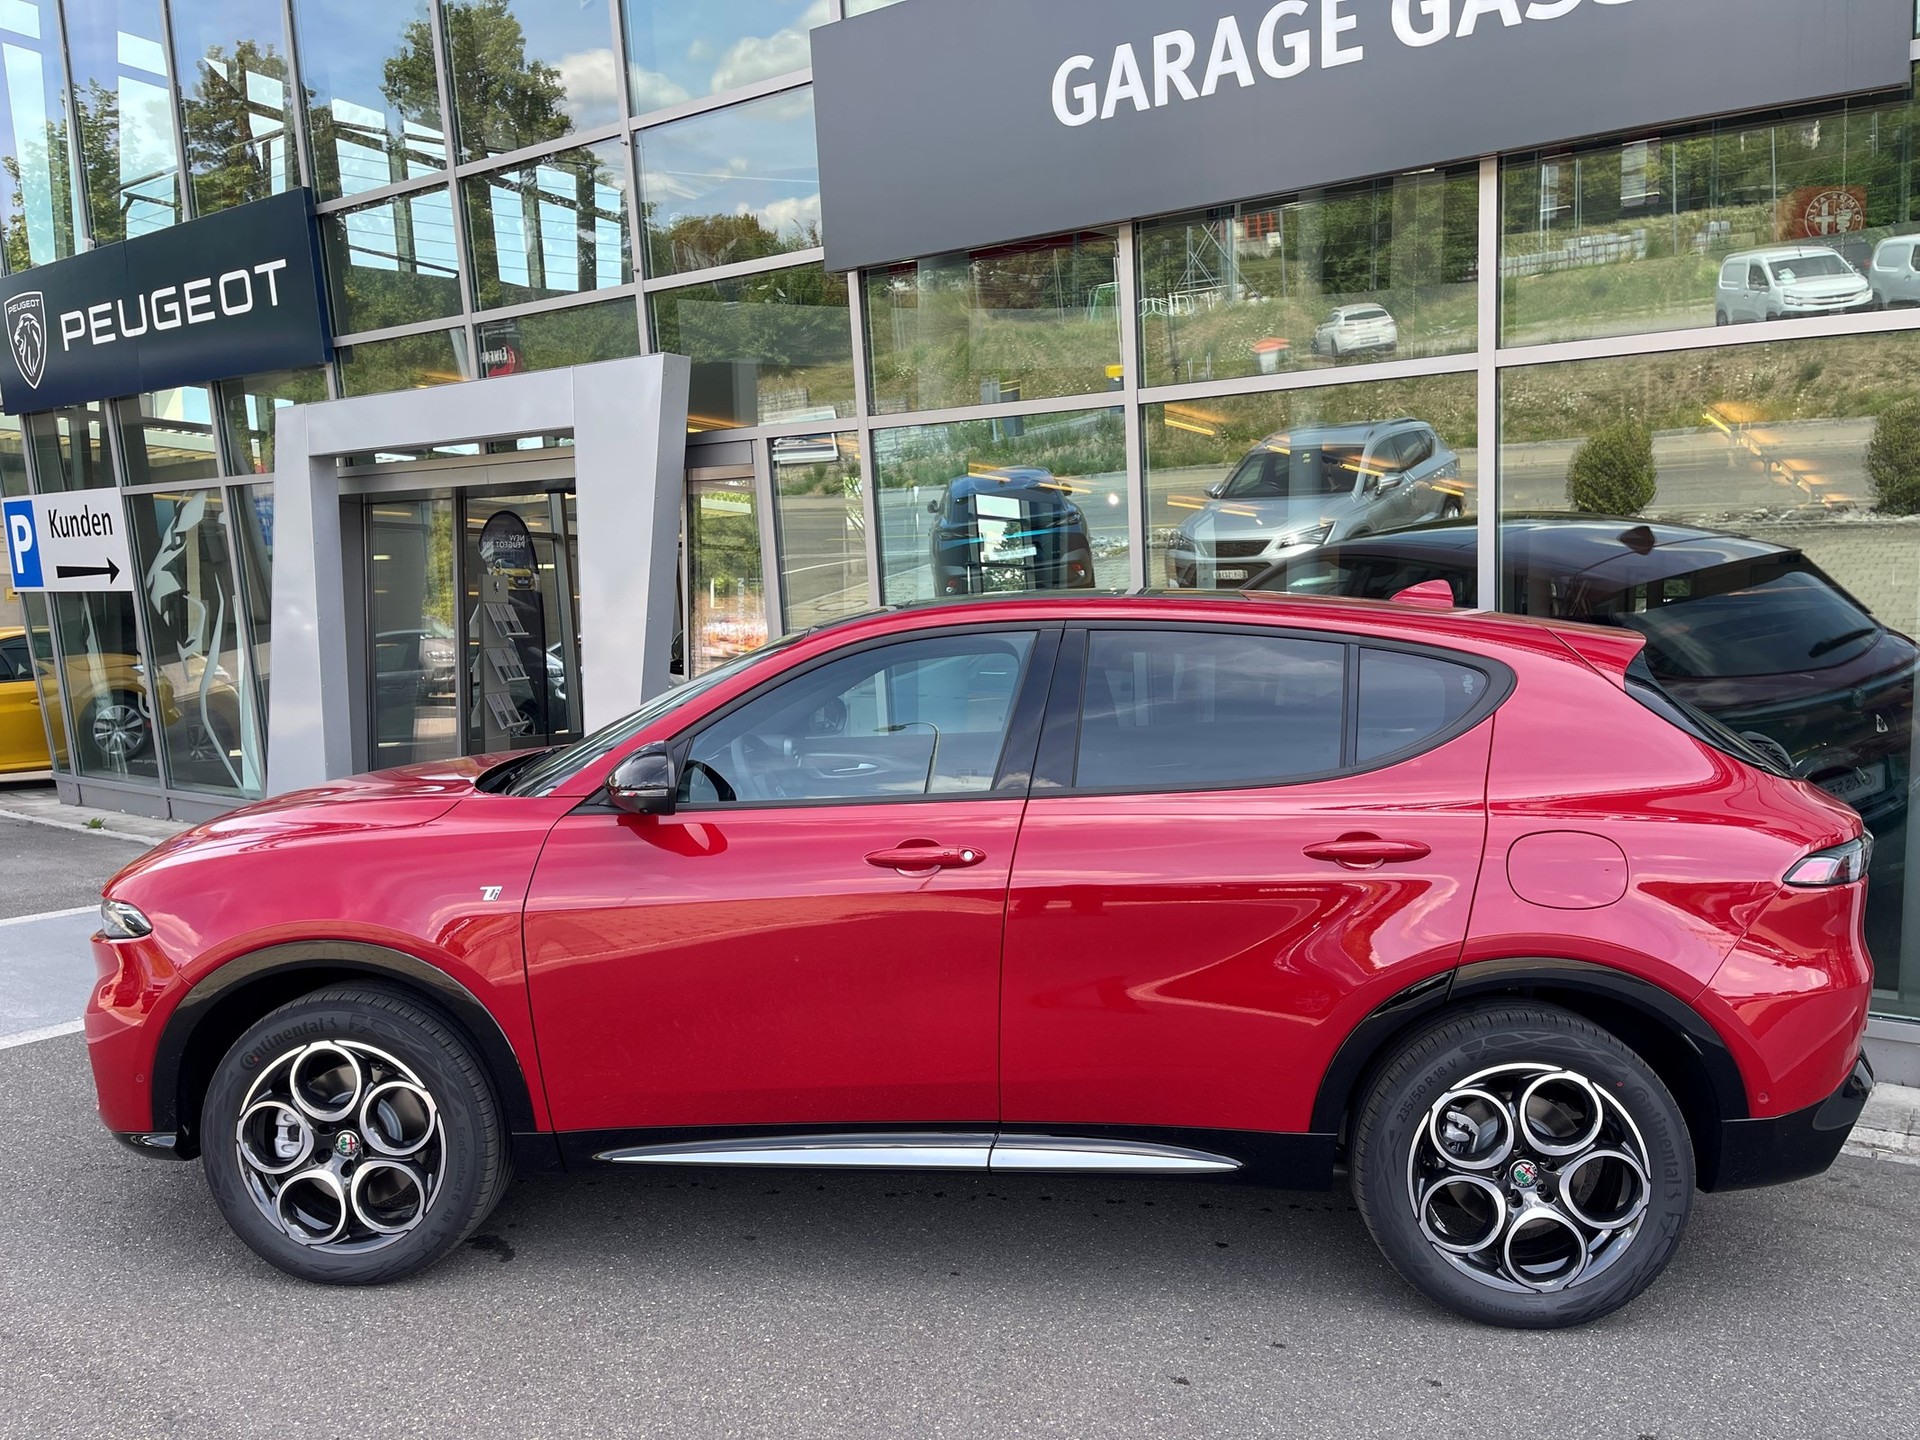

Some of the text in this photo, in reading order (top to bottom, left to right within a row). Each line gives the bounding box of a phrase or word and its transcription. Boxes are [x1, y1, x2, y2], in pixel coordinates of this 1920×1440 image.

[1051, 0, 1364, 127] GARAGE
[7, 299, 40, 315] PEUGEOT
[60, 258, 287, 351] PEUGEOT
[10, 514, 33, 574] P
[48, 504, 113, 539] Kunden
[240, 1016, 326, 1071] Continental
[1396, 1058, 1458, 1123] 235/50 R 18 V
[1628, 1086, 1683, 1185] Continental
